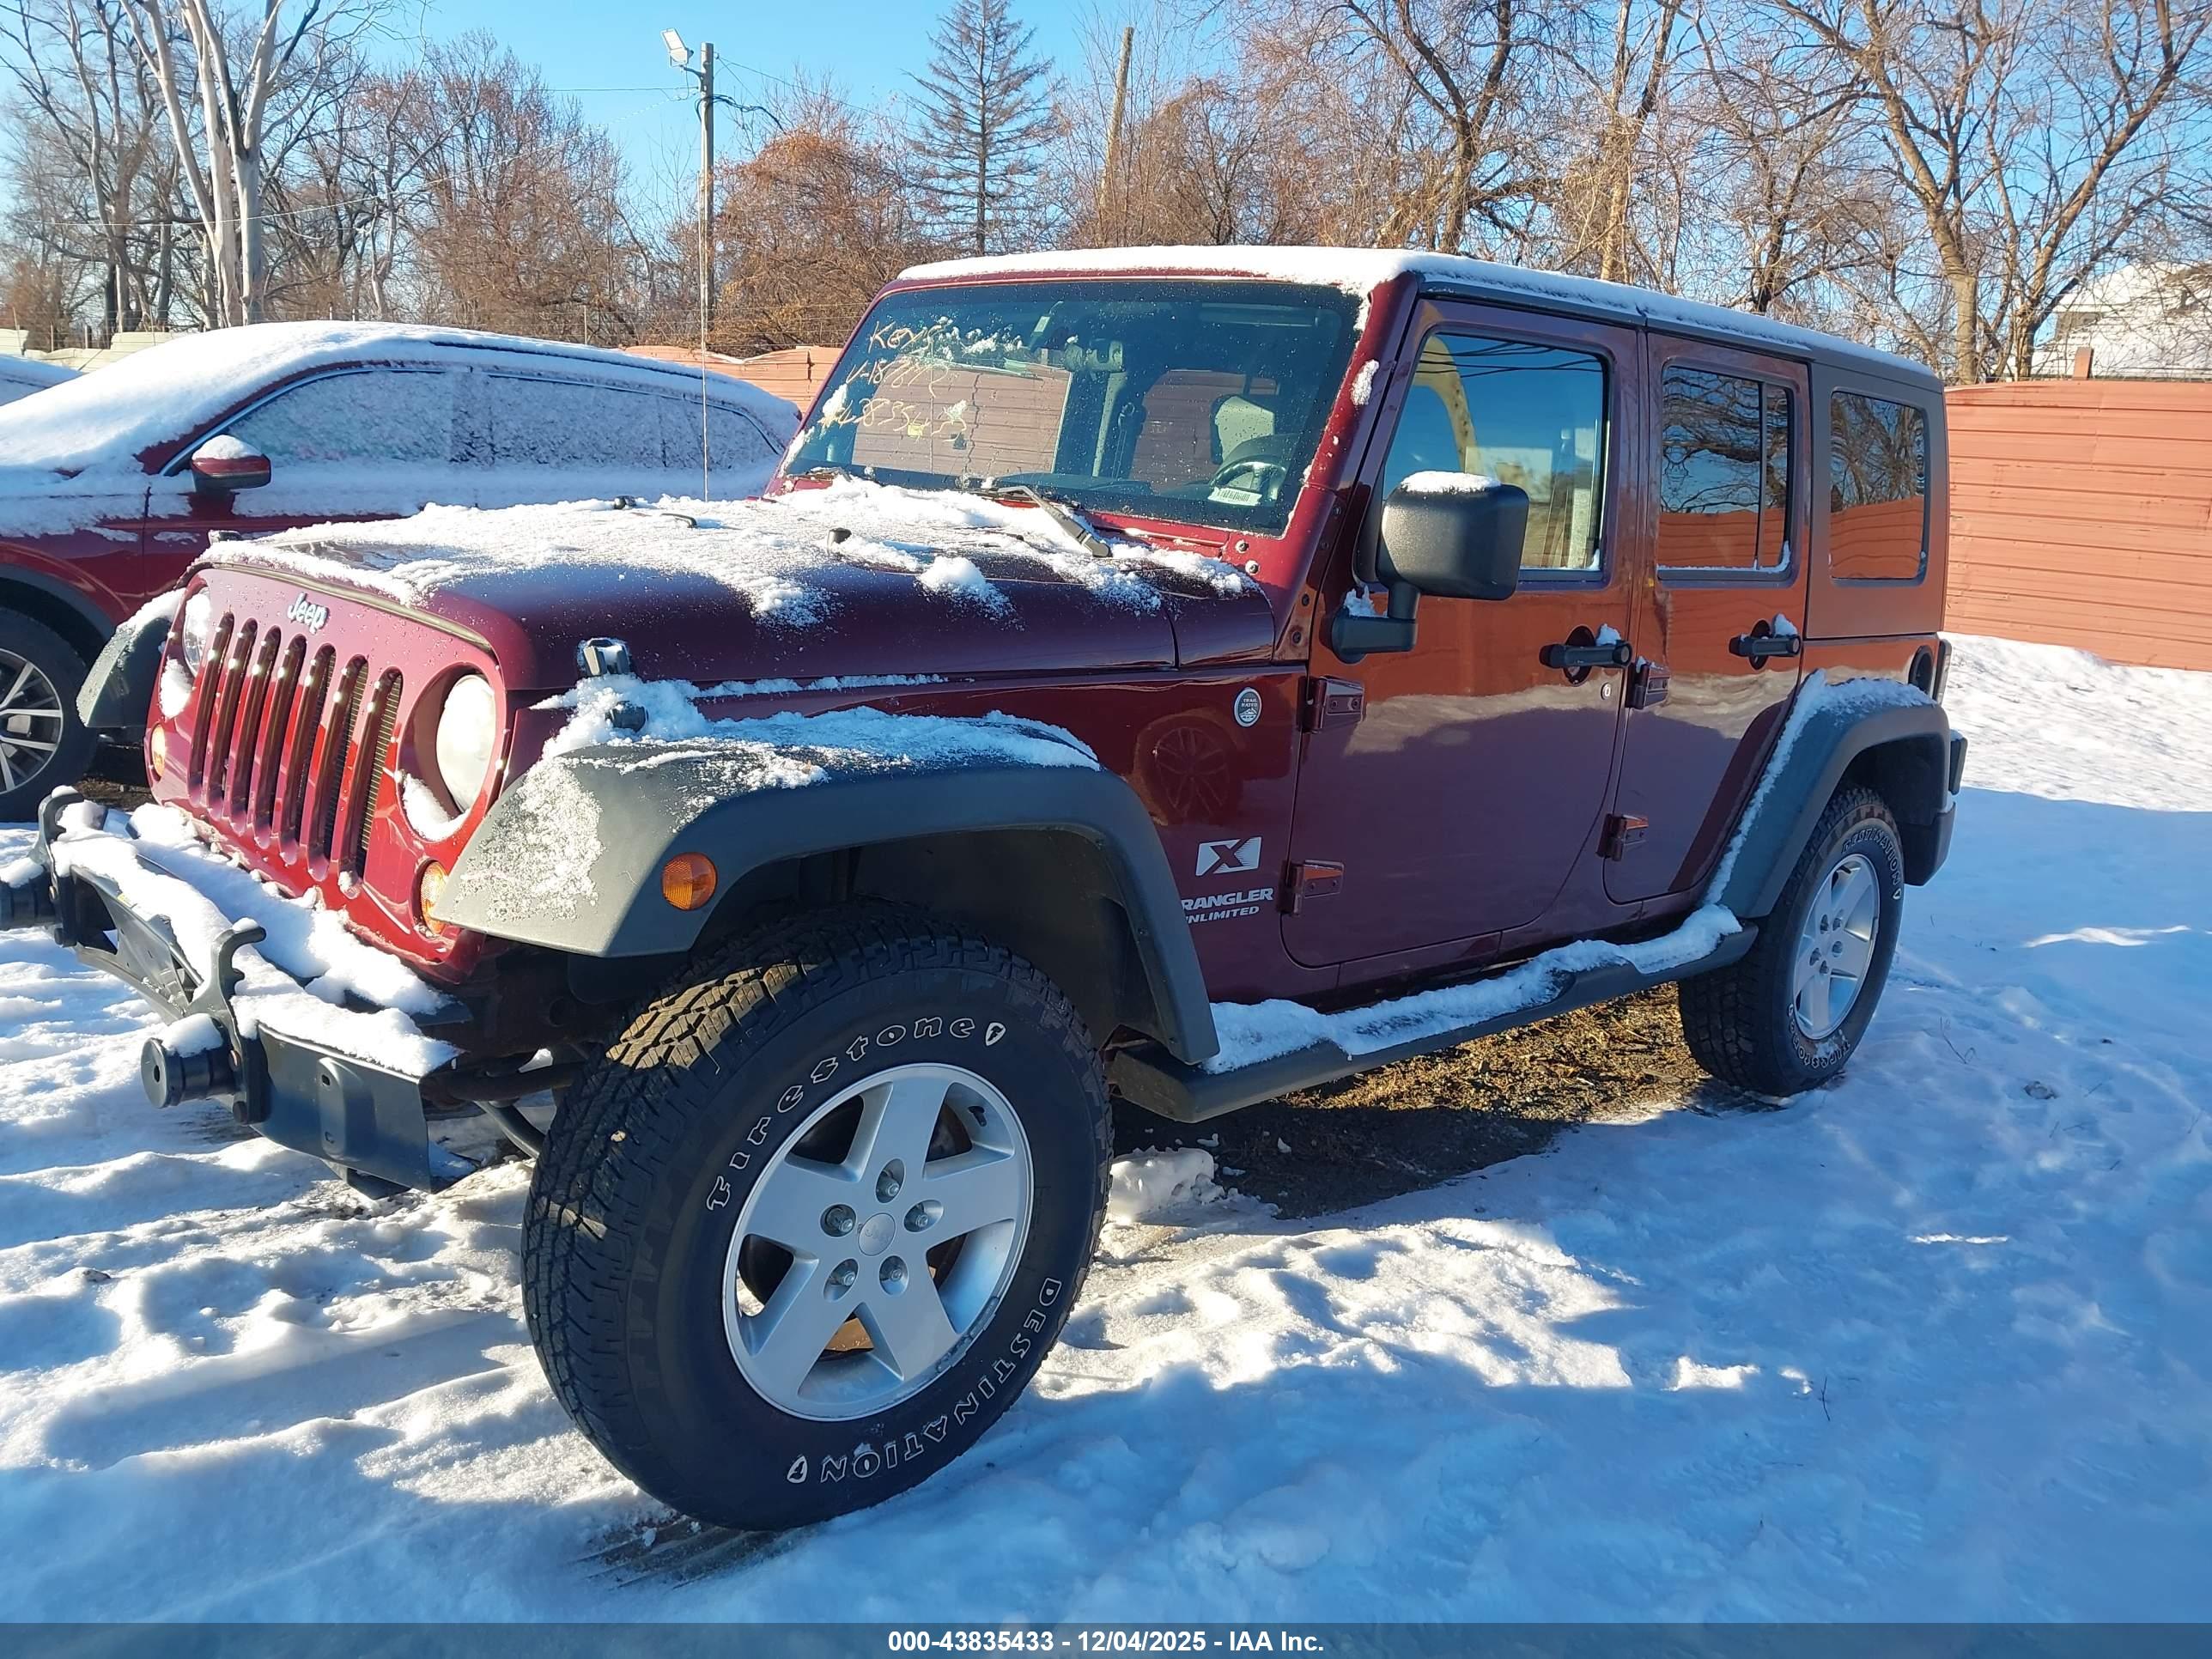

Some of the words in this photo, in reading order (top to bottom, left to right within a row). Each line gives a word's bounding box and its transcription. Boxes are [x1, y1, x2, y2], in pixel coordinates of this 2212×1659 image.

[287, 592, 328, 635] Jeep
[1181, 888, 1273, 911] RANGLER
[1186, 906, 1260, 924] NLIMITED
[706, 1016, 975, 1211] Firestone
[819, 1277, 1062, 1483] DESTINATION
